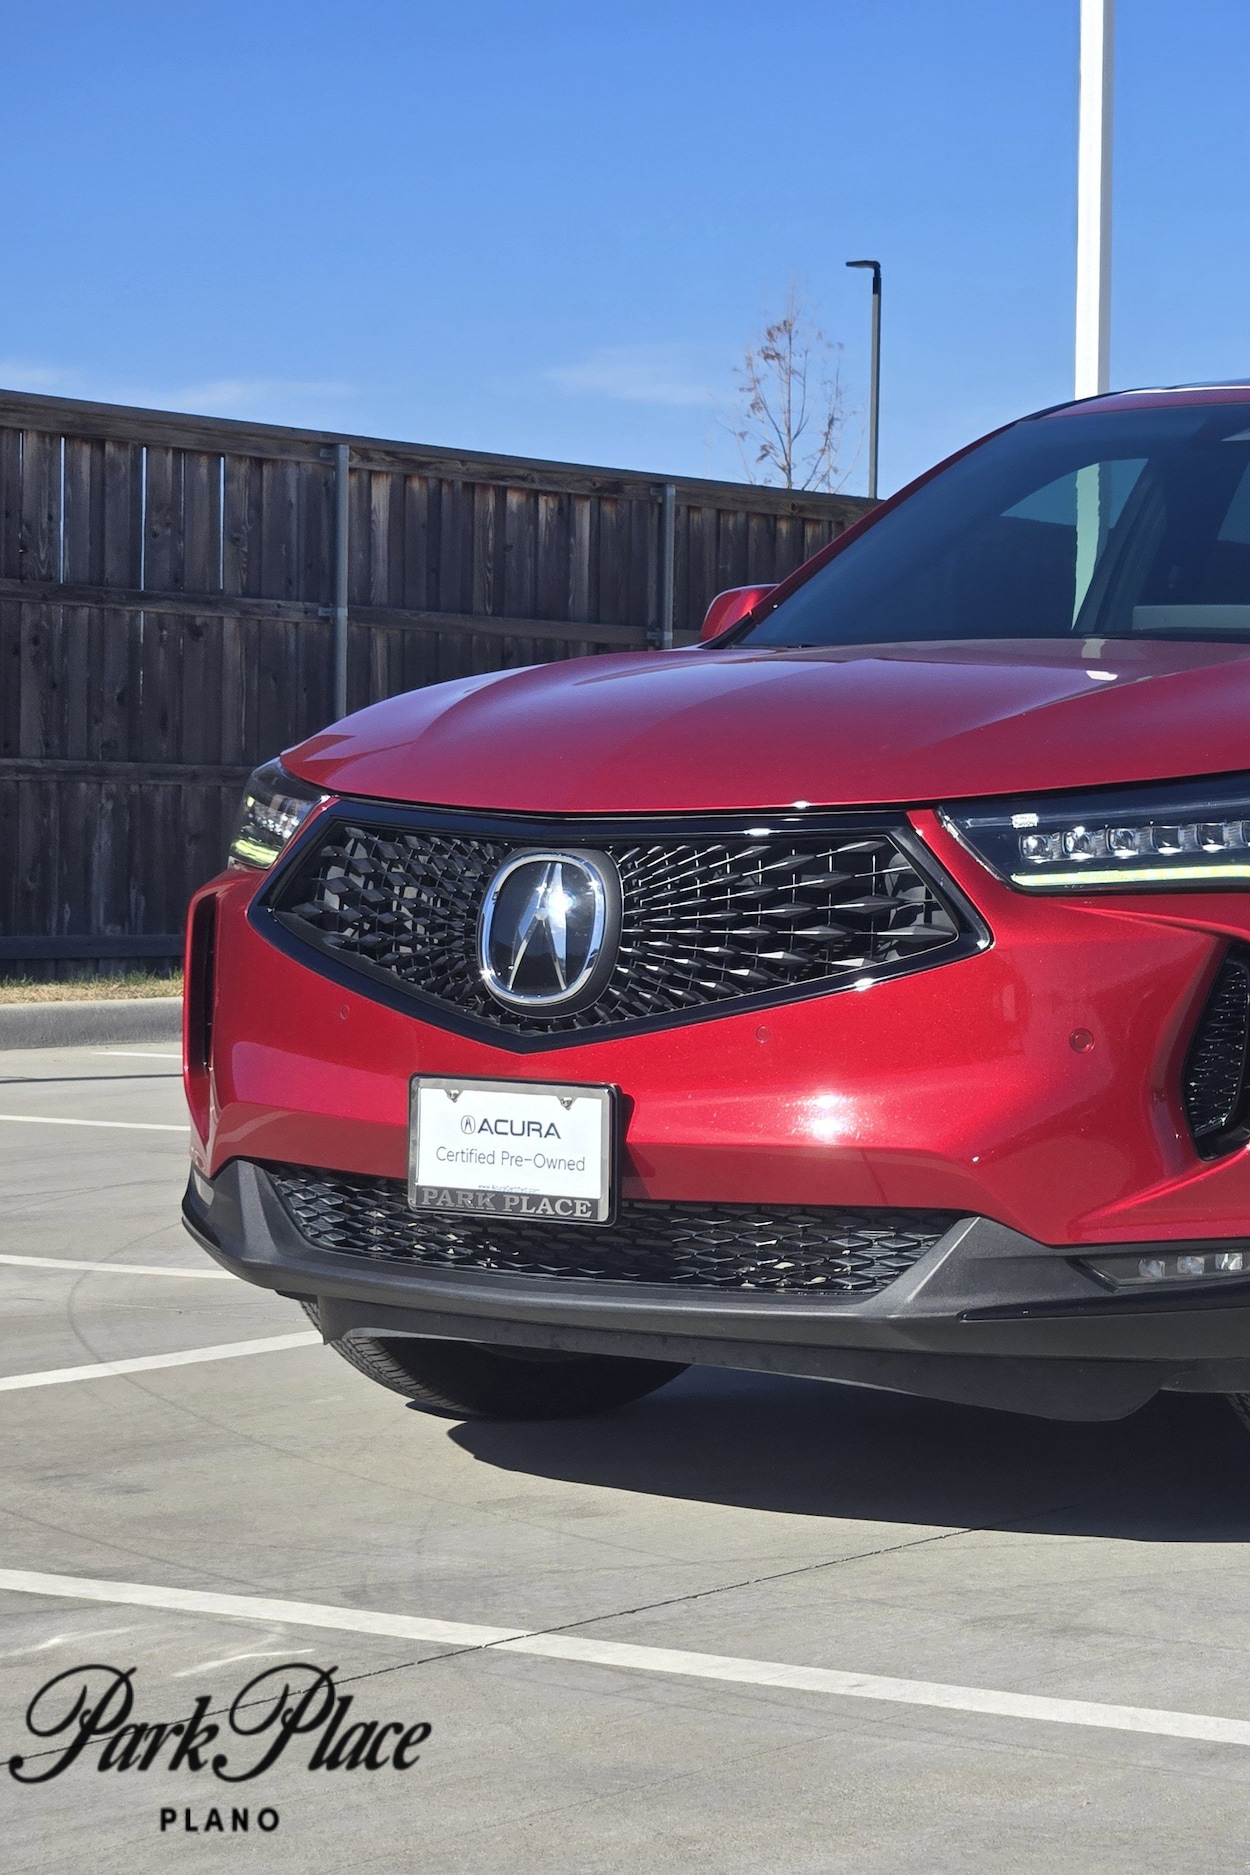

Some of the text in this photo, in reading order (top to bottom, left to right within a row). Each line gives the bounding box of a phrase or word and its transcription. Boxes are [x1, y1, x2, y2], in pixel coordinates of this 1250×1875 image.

[477, 1118, 561, 1139] ACURA
[436, 1146, 585, 1171] Certified Pre-Owned
[421, 1187, 593, 1218] PARK PLACE
